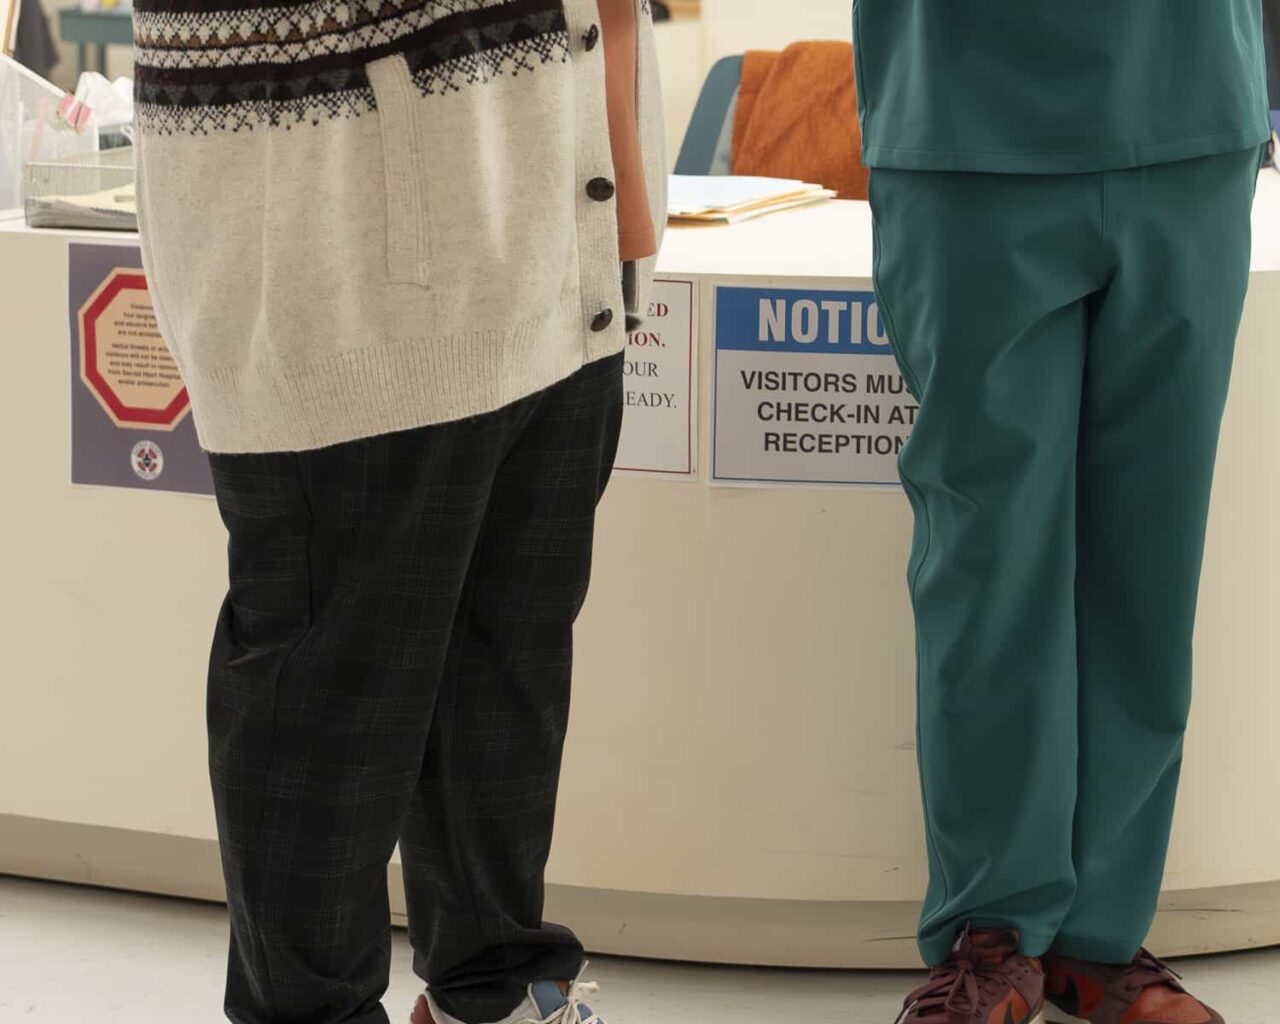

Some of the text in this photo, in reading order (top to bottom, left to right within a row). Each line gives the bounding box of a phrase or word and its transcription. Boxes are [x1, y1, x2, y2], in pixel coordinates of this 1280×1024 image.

[647, 302, 669, 317] ED
[740, 370, 912, 394] VISITORS MU
[621, 391, 677, 408] EADY.
[757, 402, 919, 425] CHECK-IN AT
